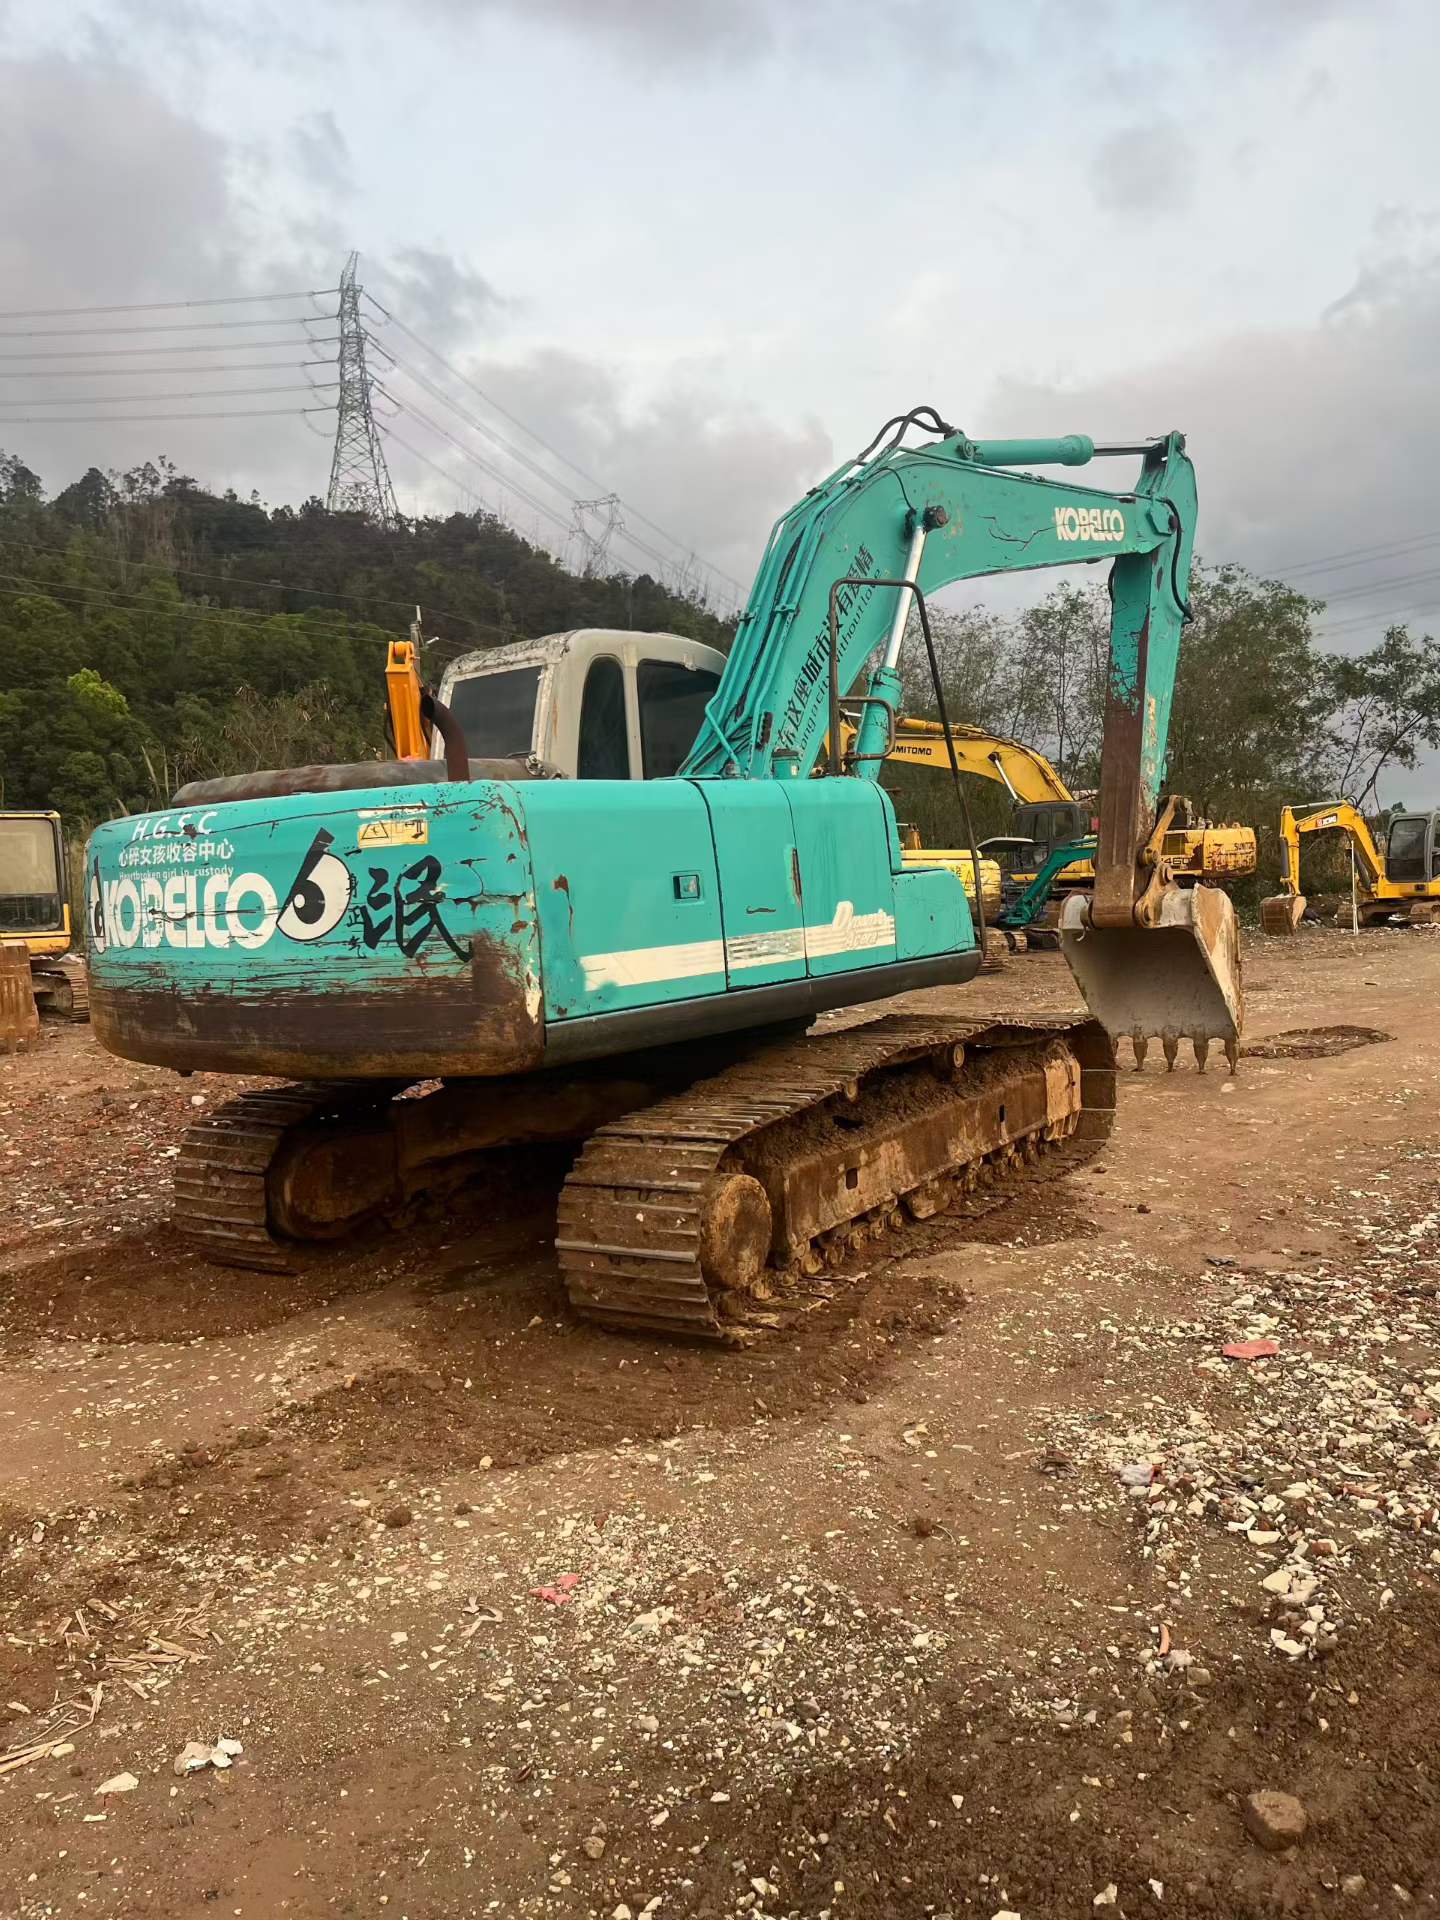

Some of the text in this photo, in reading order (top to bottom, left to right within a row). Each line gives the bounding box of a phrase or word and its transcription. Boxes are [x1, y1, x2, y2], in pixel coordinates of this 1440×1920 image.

[1055, 507, 1124, 541] KOBELCO
[118, 838, 235, 867] 心碎女孩收容中心
[181, 867, 190, 876] in
[194, 864, 235, 877] custody
[103, 872, 278, 950] KOBELCO
